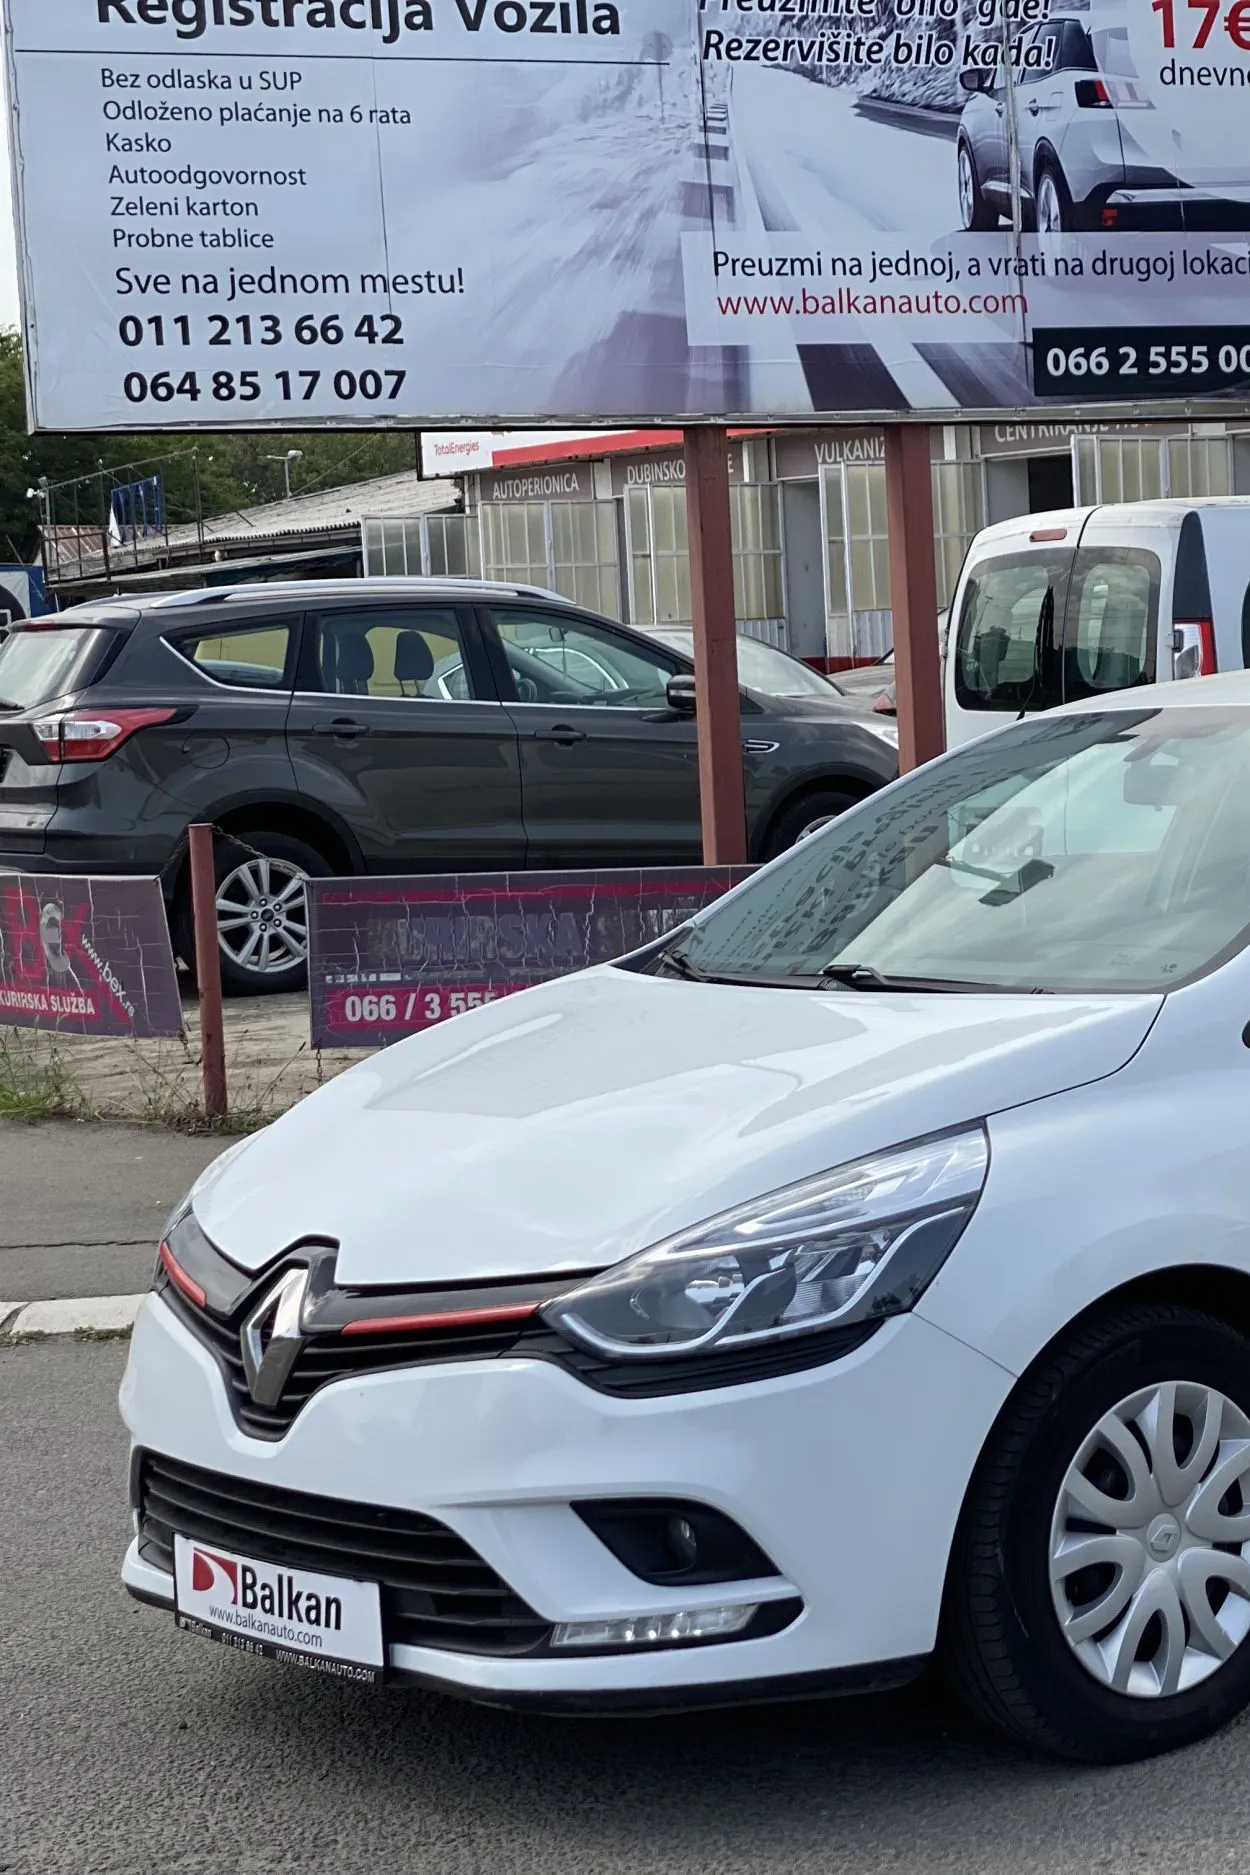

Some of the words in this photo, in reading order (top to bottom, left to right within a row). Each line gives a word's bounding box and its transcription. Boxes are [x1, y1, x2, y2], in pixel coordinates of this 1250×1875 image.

[456, 0, 621, 35] Vozila
[703, 30, 884, 63] Rezervišite
[893, 33, 953, 65] bilo
[963, 35, 1055, 67] kada!
[101, 68, 141, 90] Bez
[147, 69, 233, 91] odlaska
[239, 77, 253, 91] u
[258, 71, 302, 91] SUP
[103, 100, 212, 123] Odloženo
[219, 101, 311, 127] plaćanje
[318, 107, 343, 124] na
[350, 104, 363, 124] 6
[370, 106, 411, 125] rata
[106, 132, 172, 154] Kasko
[108, 164, 307, 190] Autoodgovornost
[110, 196, 180, 217] Zeleni
[186, 197, 259, 218] karton
[113, 228, 193, 250] Probne
[200, 229, 274, 250] tablice
[713, 250, 823, 279] Preuzmi
[831, 256, 863, 278] na
[868, 249, 960, 284] jednoj,
[967, 258, 982, 277] a
[988, 250, 1046, 278] vrati
[1054, 257, 1085, 277] na
[1091, 249, 1175, 283] drugoj
[115, 267, 172, 295] Sve
[181, 273, 219, 294] na
[226, 266, 349, 300] jednom
[359, 267, 465, 295] mestu!
[716, 288, 1028, 316] www.balkanauto.com
[119, 315, 192, 346] 011
[207, 314, 282, 346] 213
[294, 314, 344, 345] 66
[354, 313, 404, 345] 42
[1046, 346, 1110, 376] 066
[1118, 346, 1139, 375] 2
[1148, 346, 1209, 374] 555
[124, 370, 201, 402] 064
[211, 370, 261, 401] 85
[274, 369, 320, 400] 17
[332, 369, 408, 400] 007
[434, 441, 480, 456] TotalEnergies
[493, 473, 579, 499] AUTOPERIONICA
[627, 459, 686, 484] DUBINSKO
[50, 992, 95, 1015] SLUŽBA
[345, 994, 396, 1022] 066
[404, 992, 416, 1020] /
[424, 992, 441, 1019] 3
[241, 1564, 342, 1630] Balkan
[209, 1603, 323, 1648] www.balkanauto.com
[275, 1649, 375, 1683] WWW.BALKANAUTO.COM
